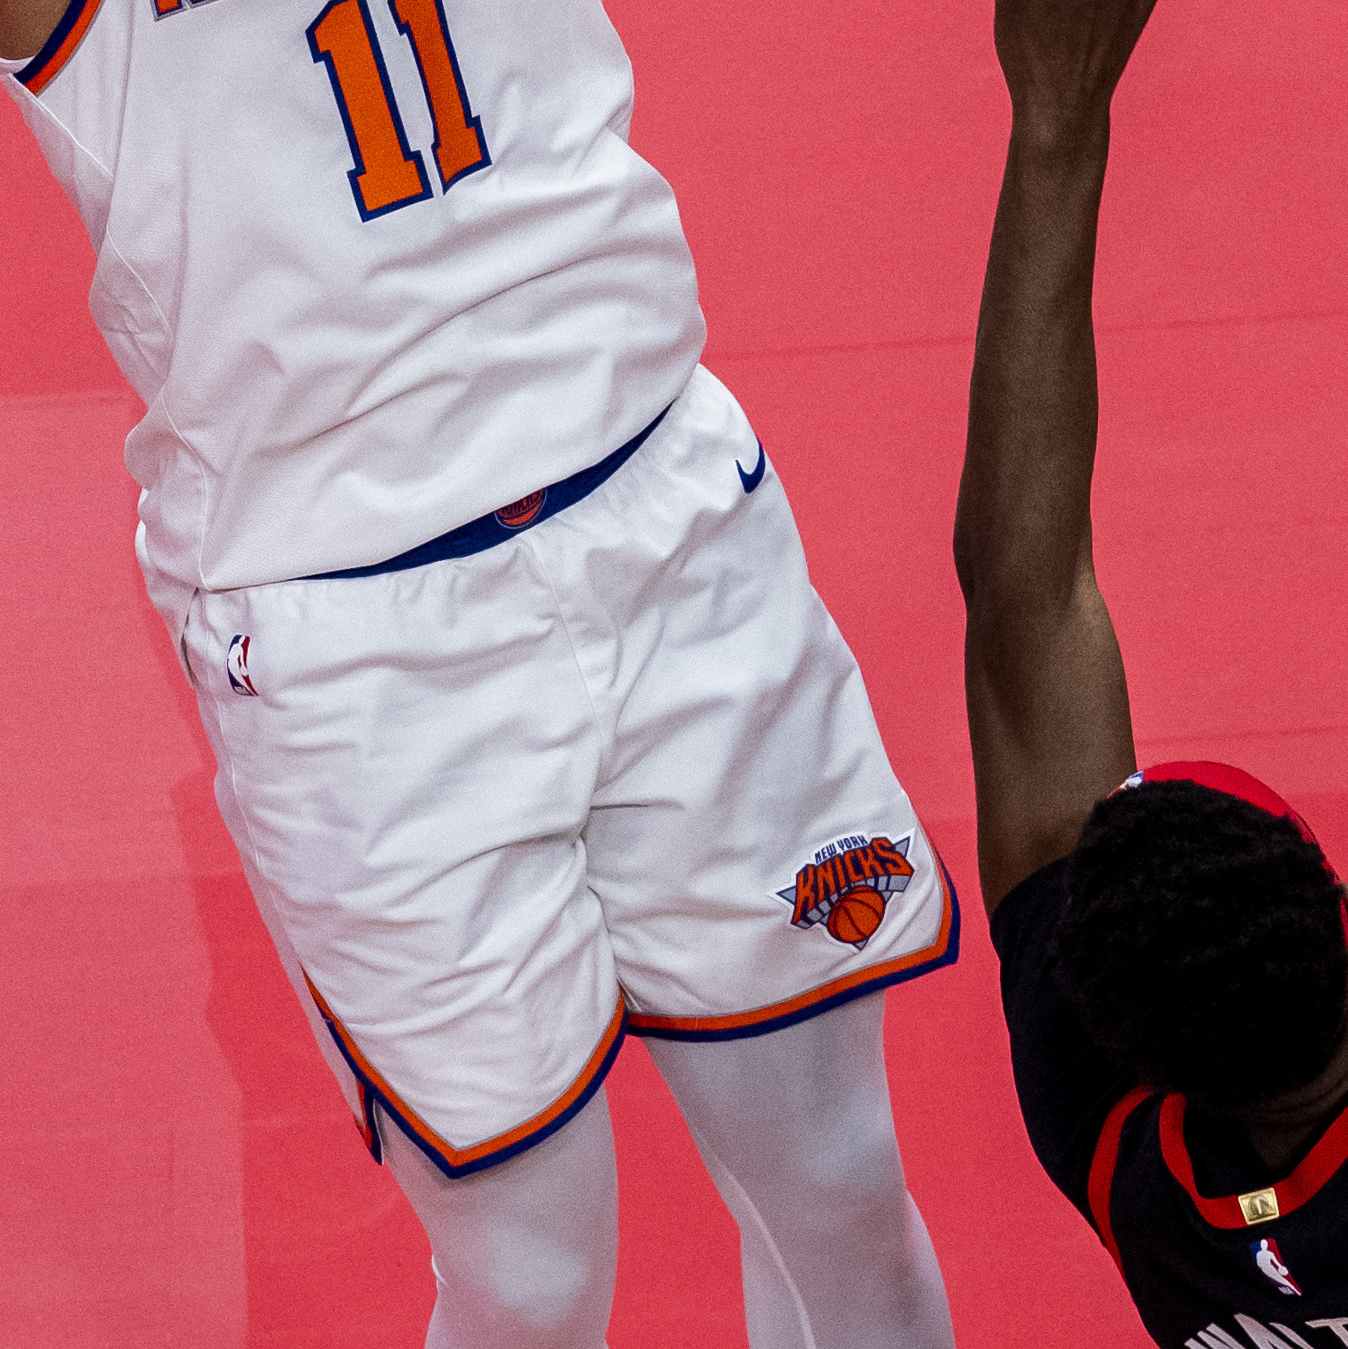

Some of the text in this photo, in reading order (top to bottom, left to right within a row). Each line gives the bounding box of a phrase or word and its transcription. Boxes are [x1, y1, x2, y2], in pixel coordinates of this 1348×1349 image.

[814, 834, 869, 864] NEW YORK
[791, 836, 915, 927] KNICKS
